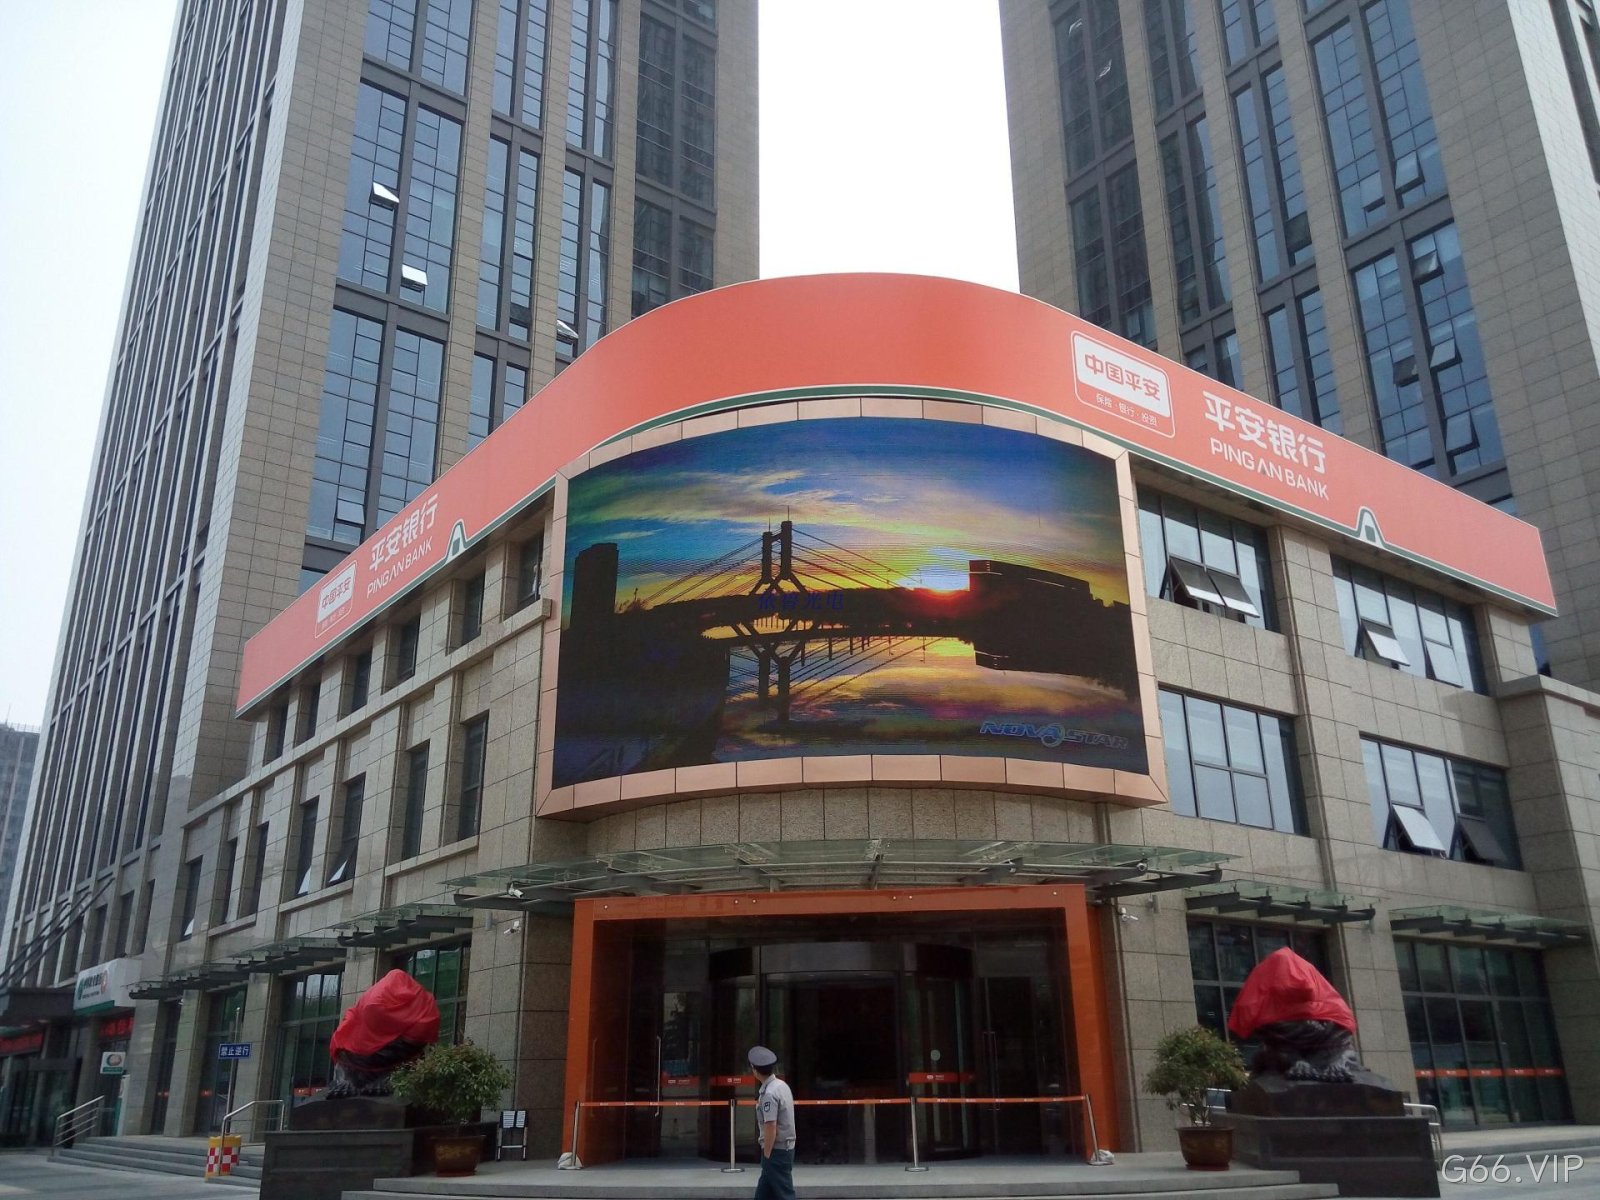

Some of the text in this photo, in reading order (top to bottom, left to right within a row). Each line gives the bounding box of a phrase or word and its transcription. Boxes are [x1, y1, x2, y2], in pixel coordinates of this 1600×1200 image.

[1084, 354, 1161, 401] 中国平安
[1203, 390, 1326, 474] 平安银行
[1284, 468, 1329, 500] BANK
[369, 493, 438, 571] 平安银行
[405, 536, 433, 569] BANK
